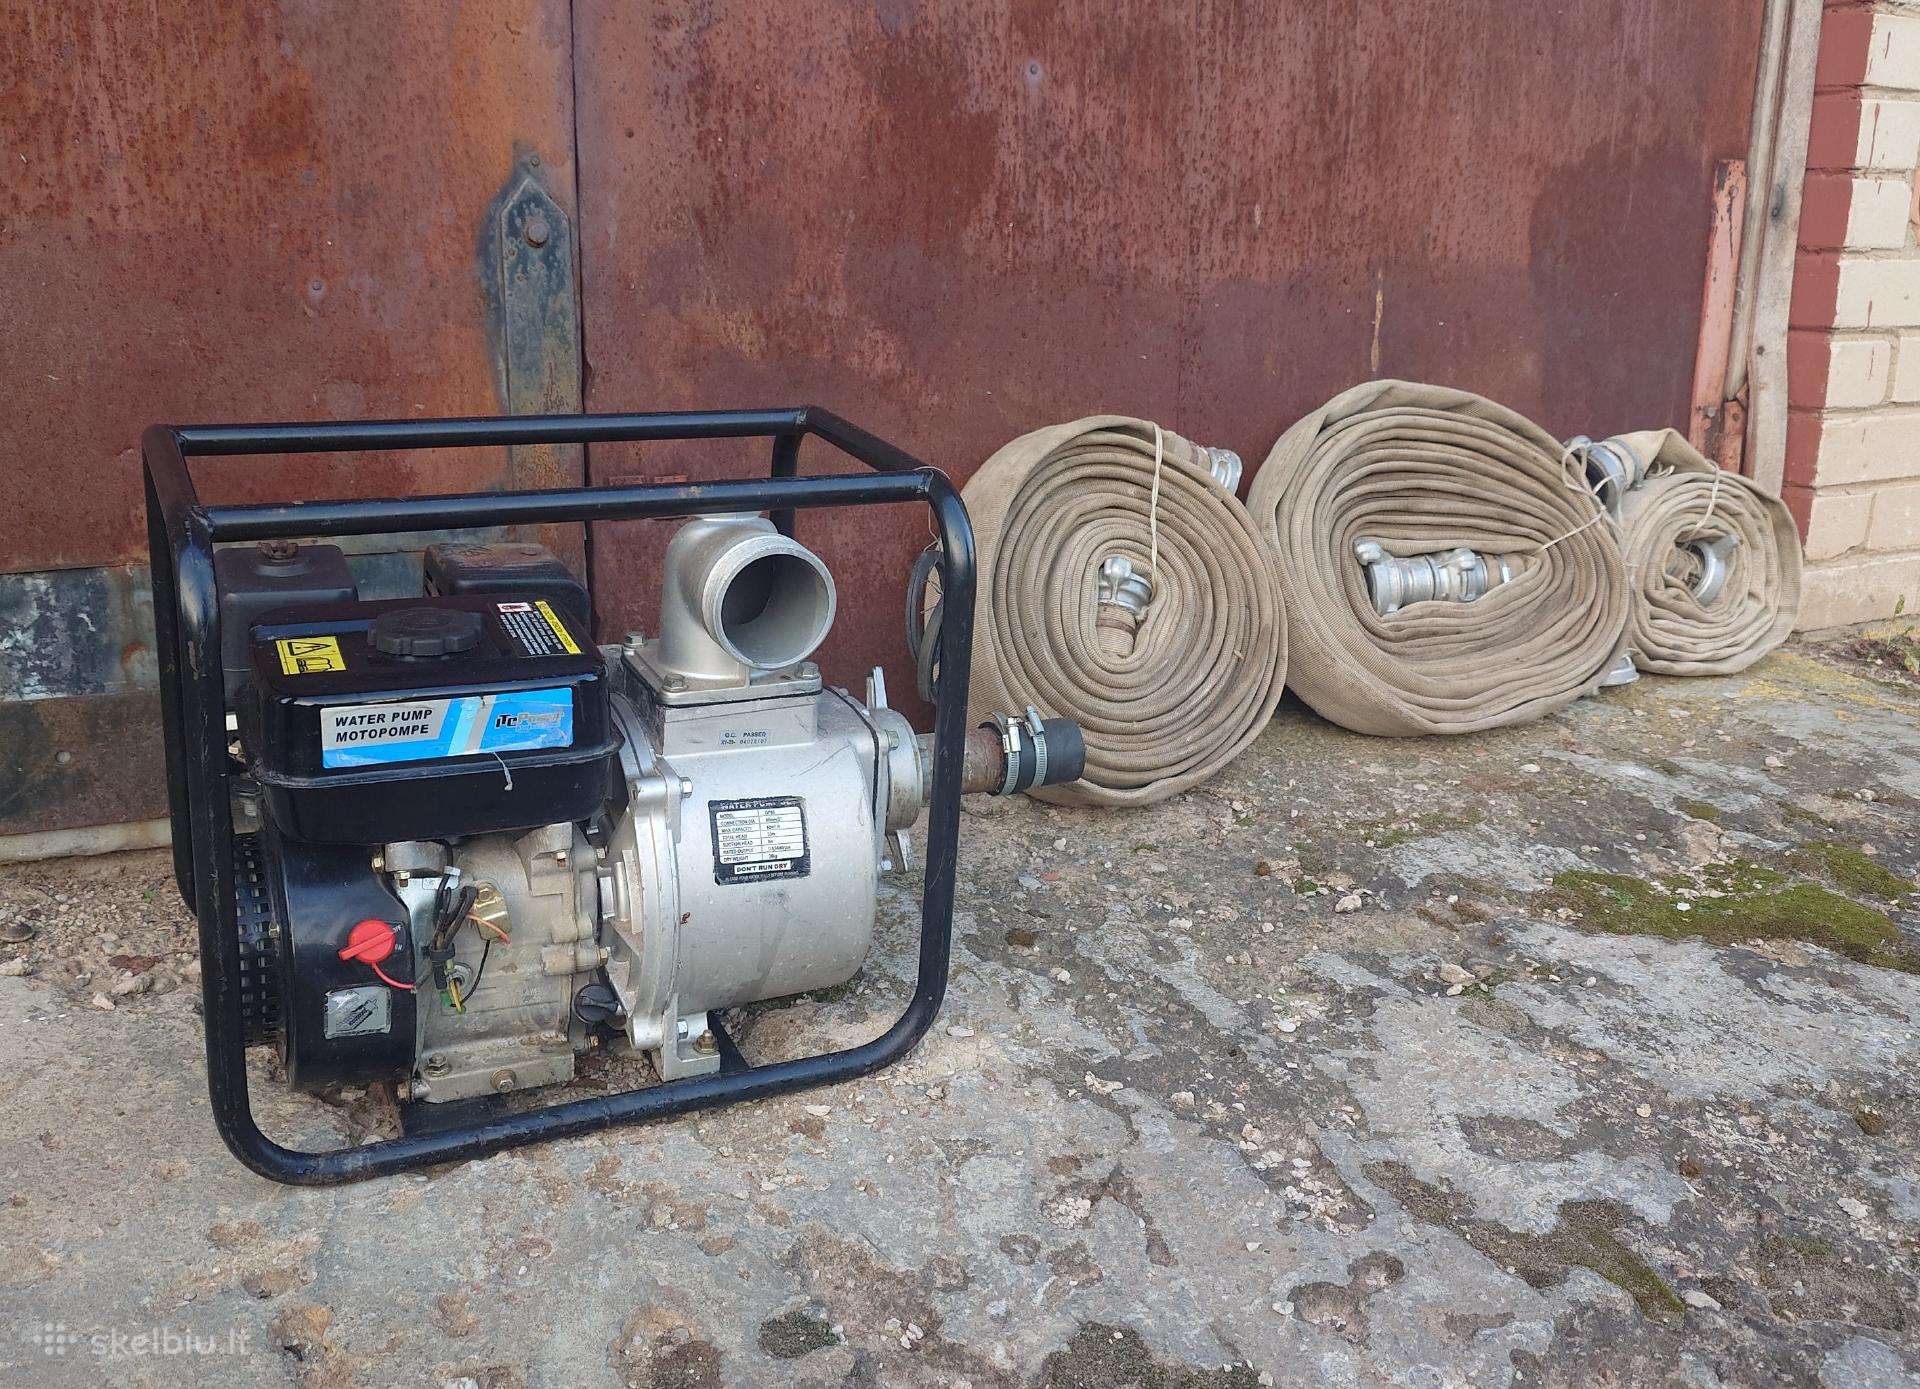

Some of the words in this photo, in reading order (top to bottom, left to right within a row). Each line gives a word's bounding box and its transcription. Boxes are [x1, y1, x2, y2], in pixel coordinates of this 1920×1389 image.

[335, 712, 386, 727] WATER
[391, 708, 433, 723] PUMP
[335, 724, 429, 743] MOTOPOMPE
[720, 801, 751, 810] WATER
[736, 865, 757, 873] DON'T
[758, 863, 773, 871] RUN
[774, 862, 788, 870] DRY
